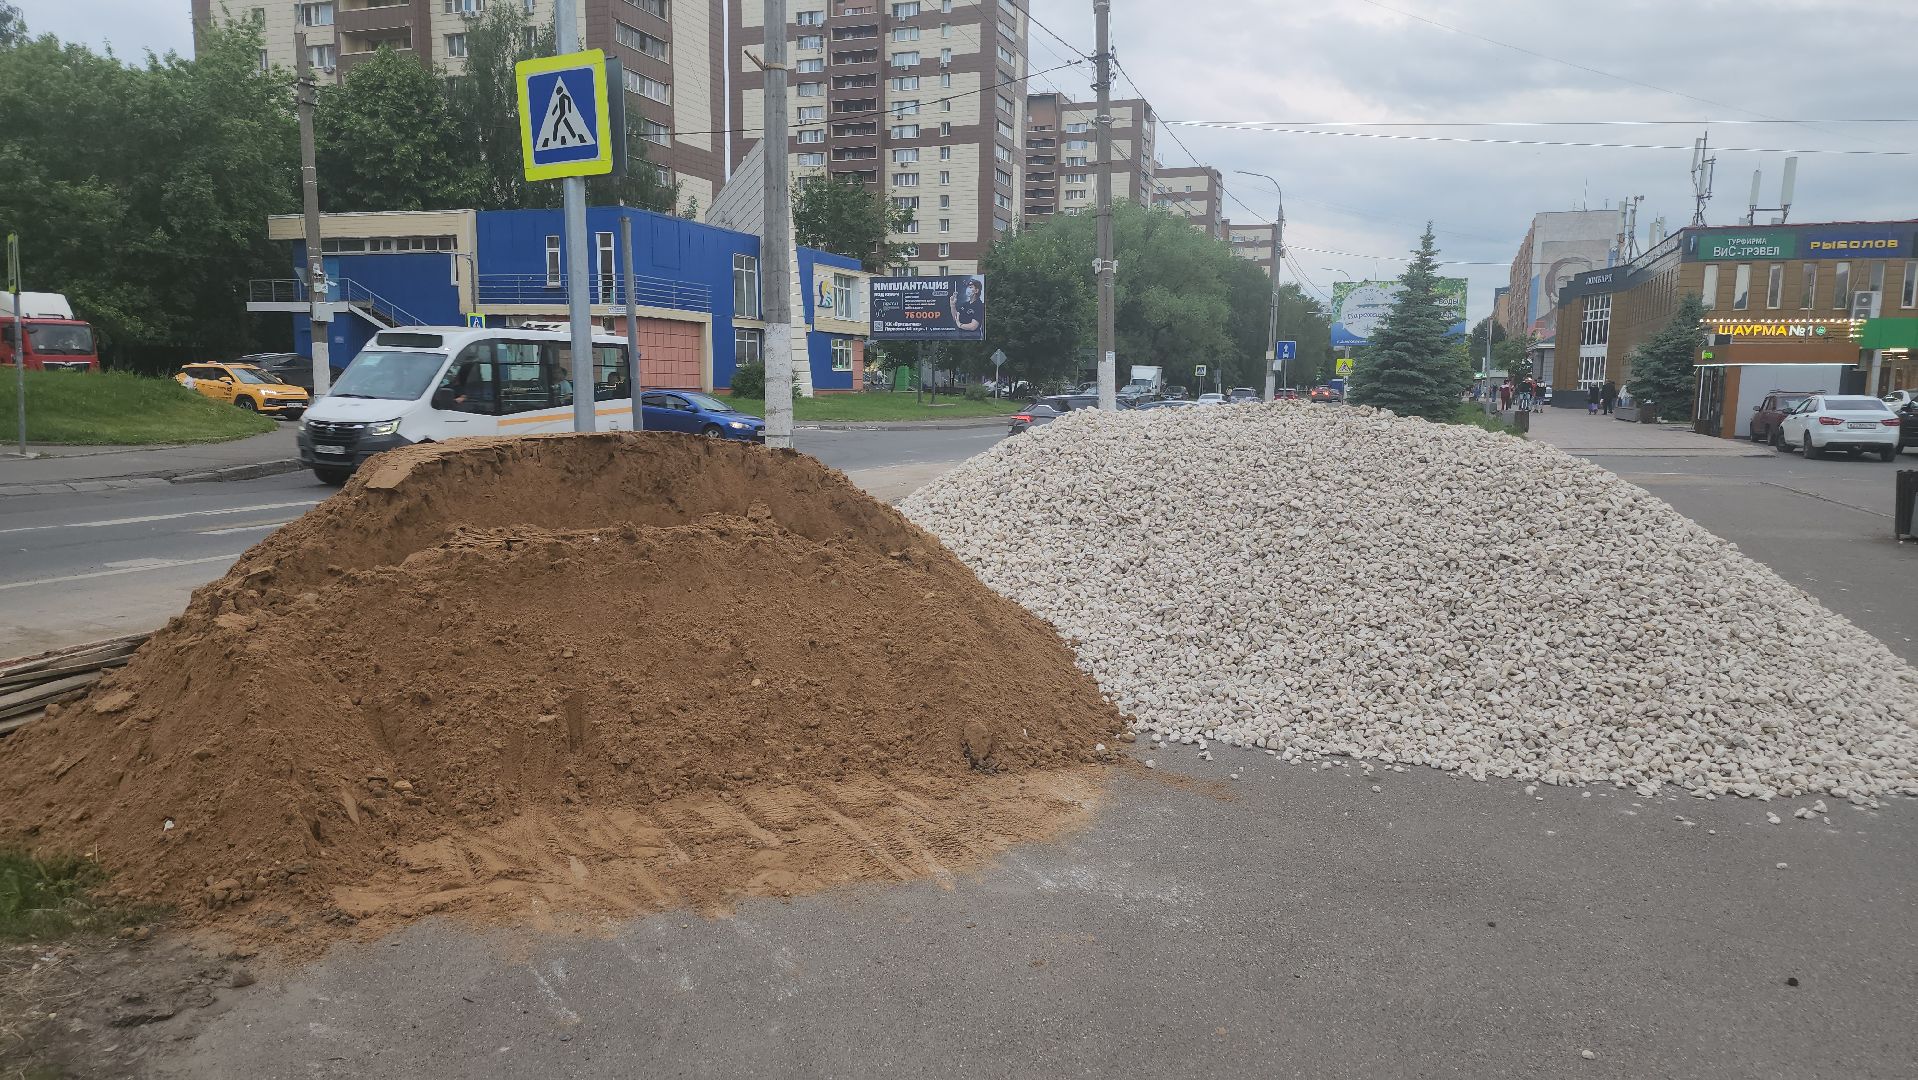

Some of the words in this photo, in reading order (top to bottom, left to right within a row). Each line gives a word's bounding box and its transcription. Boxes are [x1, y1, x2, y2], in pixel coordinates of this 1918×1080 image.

[1810, 239, 1898, 249] РЫБОЛОВ
[873, 281, 949, 291] ИМПЛАНТАЦИЯ
[1718, 324, 1787, 336] ШАУРМА
